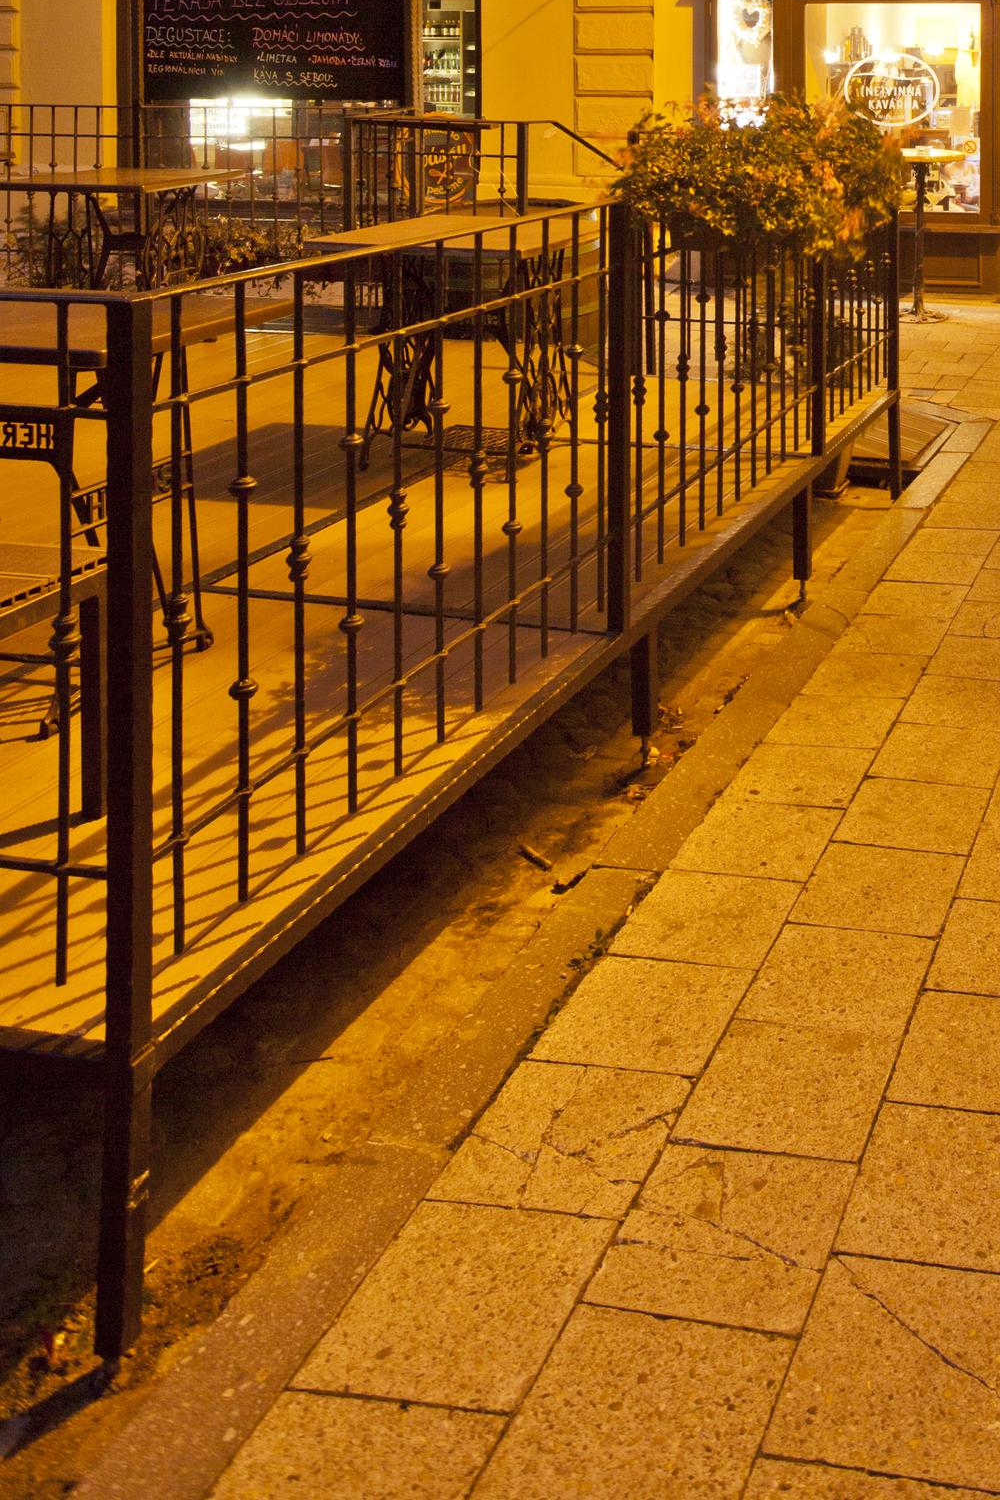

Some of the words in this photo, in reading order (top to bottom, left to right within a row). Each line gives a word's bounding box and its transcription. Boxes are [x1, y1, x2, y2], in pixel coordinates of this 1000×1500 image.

[146, 26, 231, 43] DEGUSTACE:
[253, 65, 279, 81] KÁVA
[286, 71, 294, 81] S
